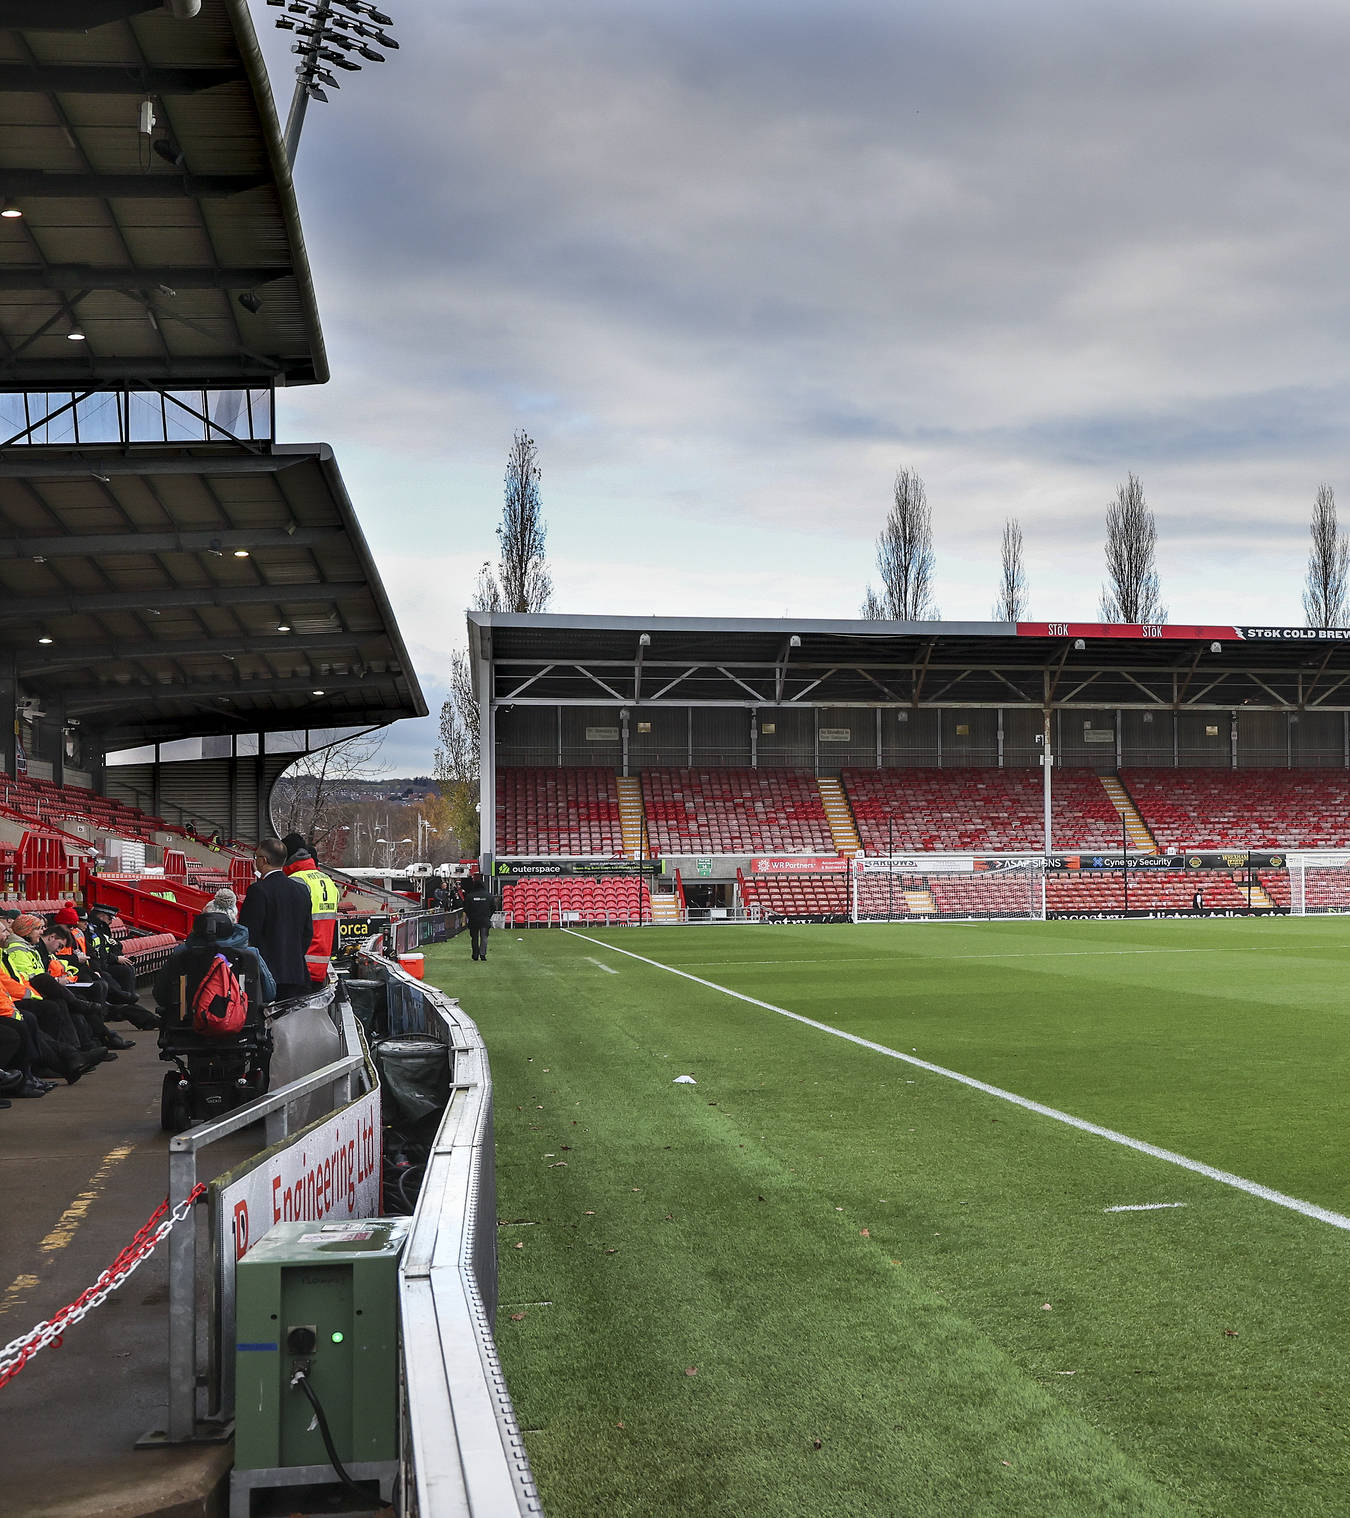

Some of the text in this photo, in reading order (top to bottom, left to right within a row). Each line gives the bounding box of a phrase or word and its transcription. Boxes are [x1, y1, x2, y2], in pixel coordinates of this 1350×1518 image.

[1283, 630, 1316, 639] COLD
[1103, 858, 1172, 867] Cynegy Security
[512, 866, 561, 874] outerspace
[319, 879, 328, 902] 3
[272, 1128, 355, 1225] Engineering
[357, 1104, 375, 1185] Ltd
